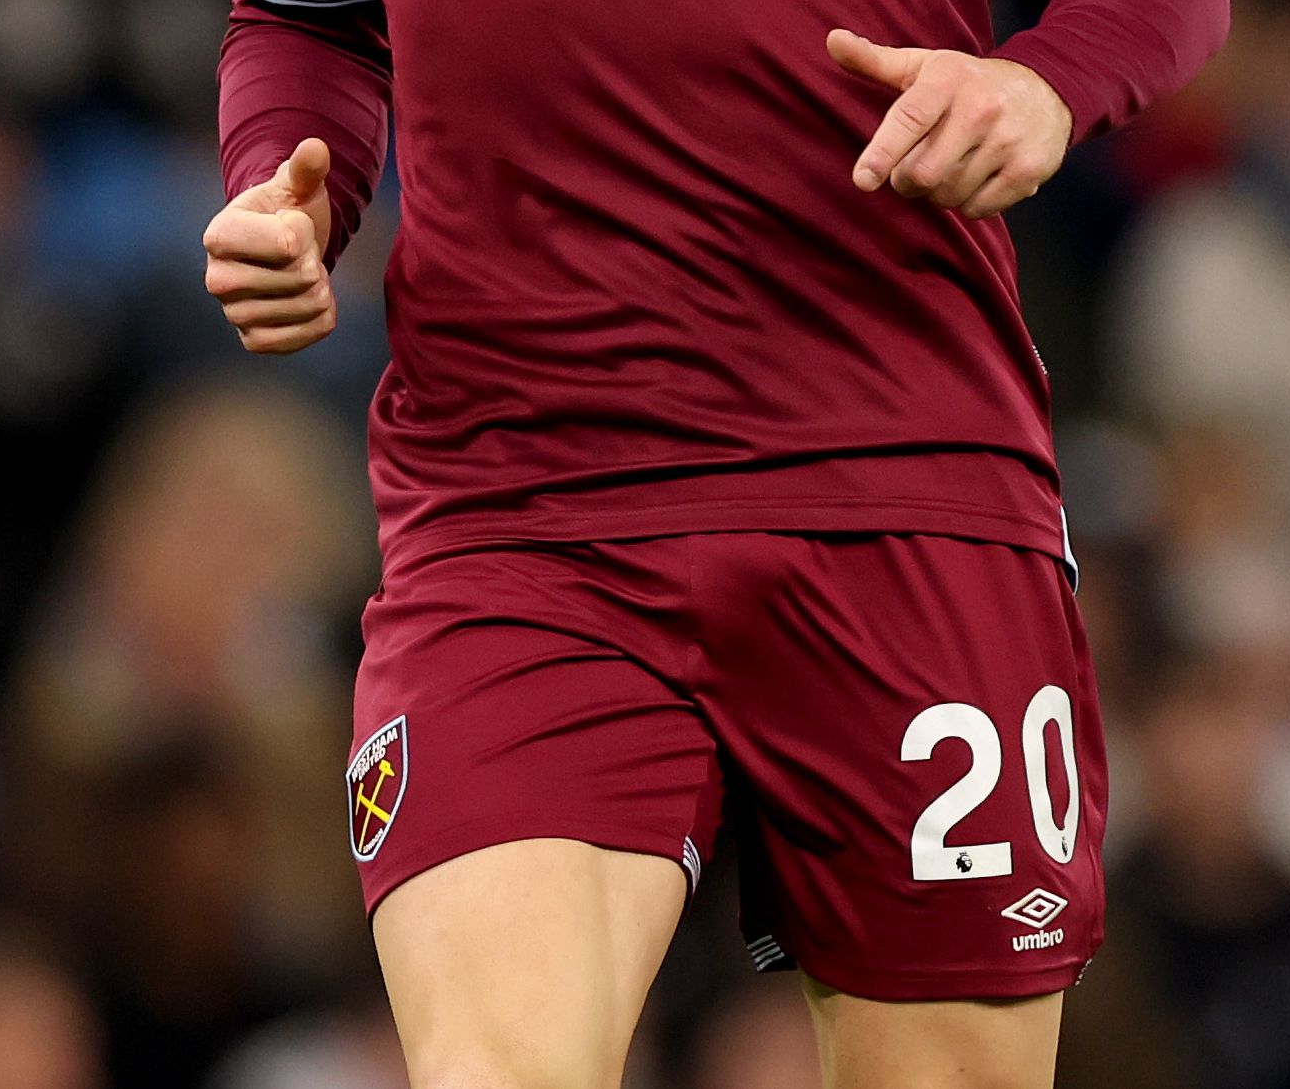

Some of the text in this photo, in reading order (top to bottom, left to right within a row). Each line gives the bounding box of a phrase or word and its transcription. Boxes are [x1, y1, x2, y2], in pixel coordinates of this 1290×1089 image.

[371, 727, 398, 753] HAM
[900, 685, 1080, 880] 20
[1013, 928, 1064, 952] umbro
